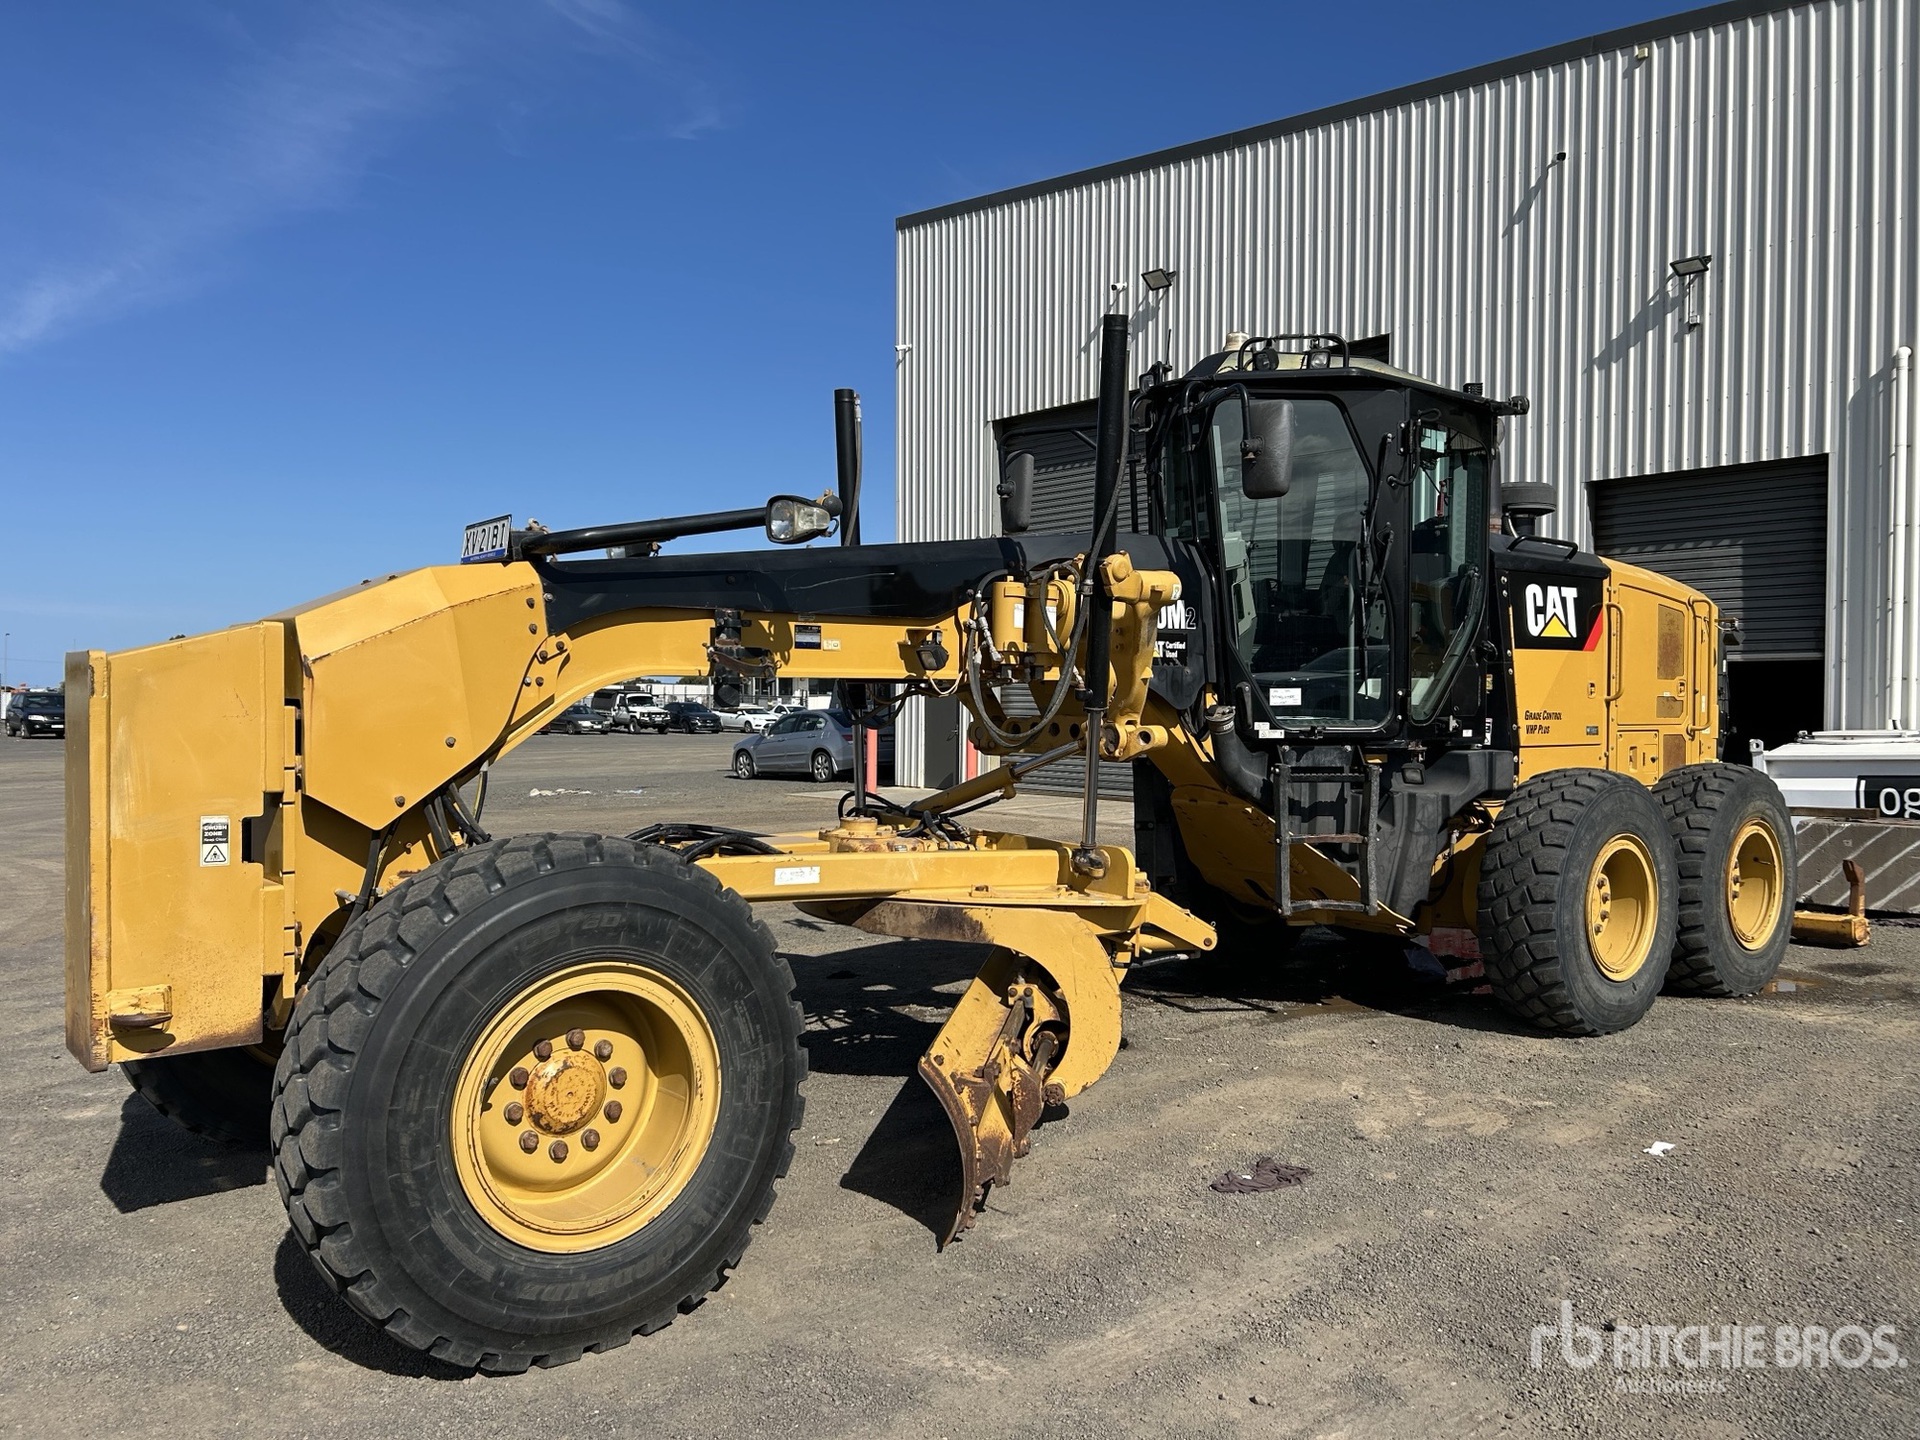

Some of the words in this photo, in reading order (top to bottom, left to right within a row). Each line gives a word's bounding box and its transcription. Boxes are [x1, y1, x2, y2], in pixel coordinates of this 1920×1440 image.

[1525, 583, 1578, 638] CAT
[1165, 641, 1186, 650] Certified
[1525, 724, 1538, 734] VHP
